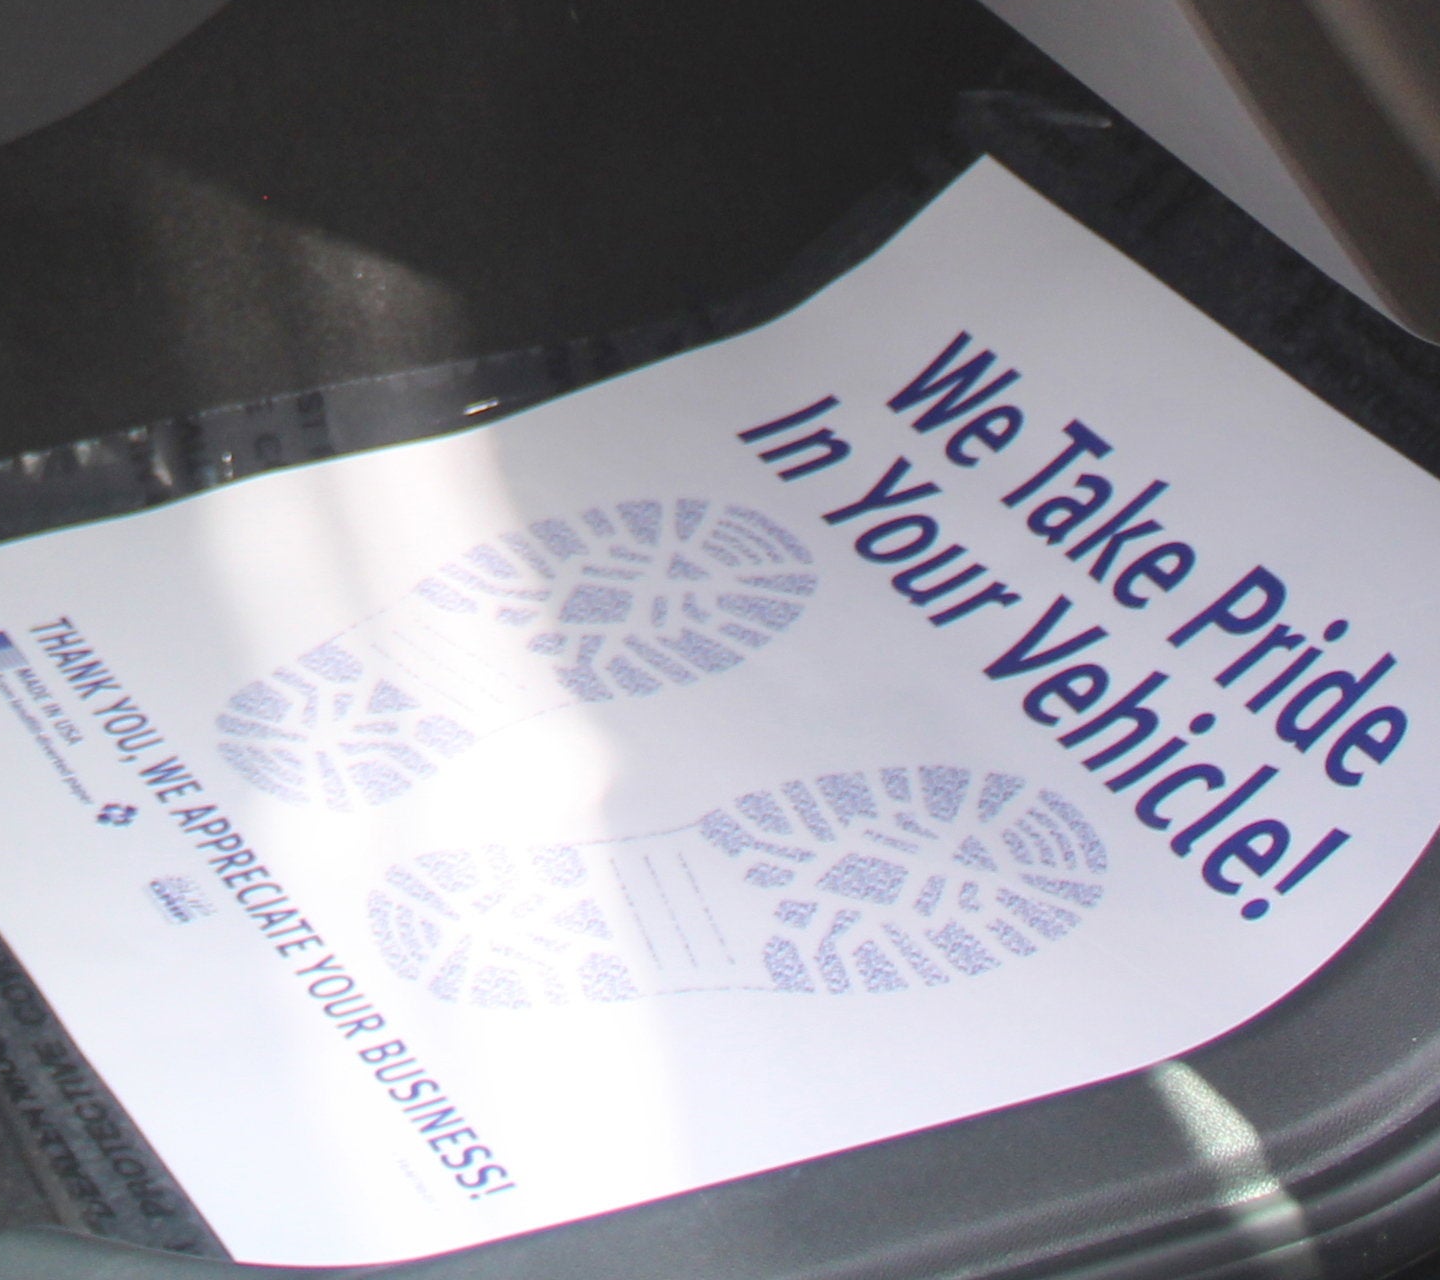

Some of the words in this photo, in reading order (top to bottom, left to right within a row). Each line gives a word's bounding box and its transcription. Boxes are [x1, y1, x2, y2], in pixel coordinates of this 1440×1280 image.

[886, 330, 1024, 468] We
[1001, 418, 1198, 610] Take
[1166, 565, 1409, 788] Pride
[29, 616, 122, 700] THANK
[737, 395, 852, 482] In
[821, 456, 1022, 628] Your
[982, 594, 1352, 921] Vehicle!
[16, 667, 52, 701] MADE
[41, 703, 63, 718] IN
[54, 719, 84, 745] USA
[92, 696, 164, 763] YOU,
[138, 756, 204, 804] WE
[169, 804, 325, 959] APPRECIATE
[295, 954, 387, 1040] YOUR
[356, 1039, 516, 1200] BUSINESS!
